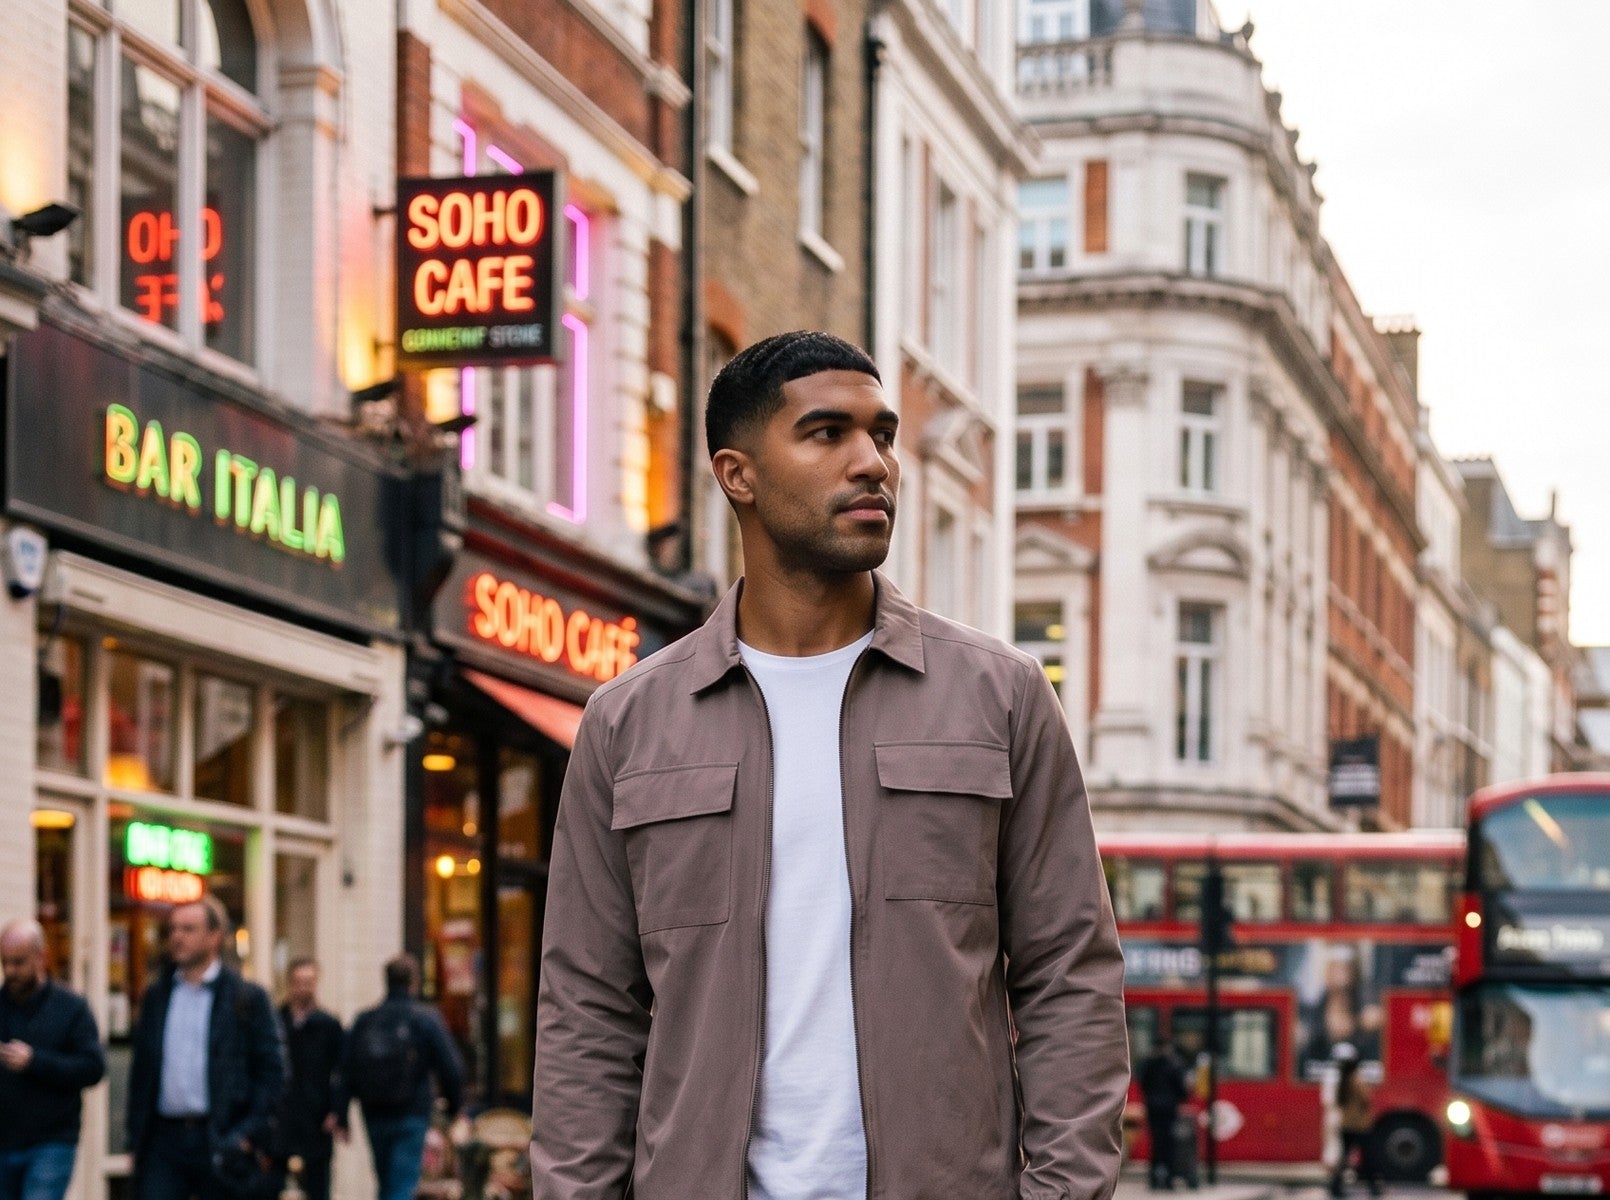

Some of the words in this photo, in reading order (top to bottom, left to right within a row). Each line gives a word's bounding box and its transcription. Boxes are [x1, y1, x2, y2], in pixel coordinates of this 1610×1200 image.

[407, 187, 542, 250] SOHO
[413, 254, 535, 316] CAFE
[105, 403, 202, 511] BAR
[214, 449, 346, 563] ITALIA
[470, 572, 565, 664] SOHO
